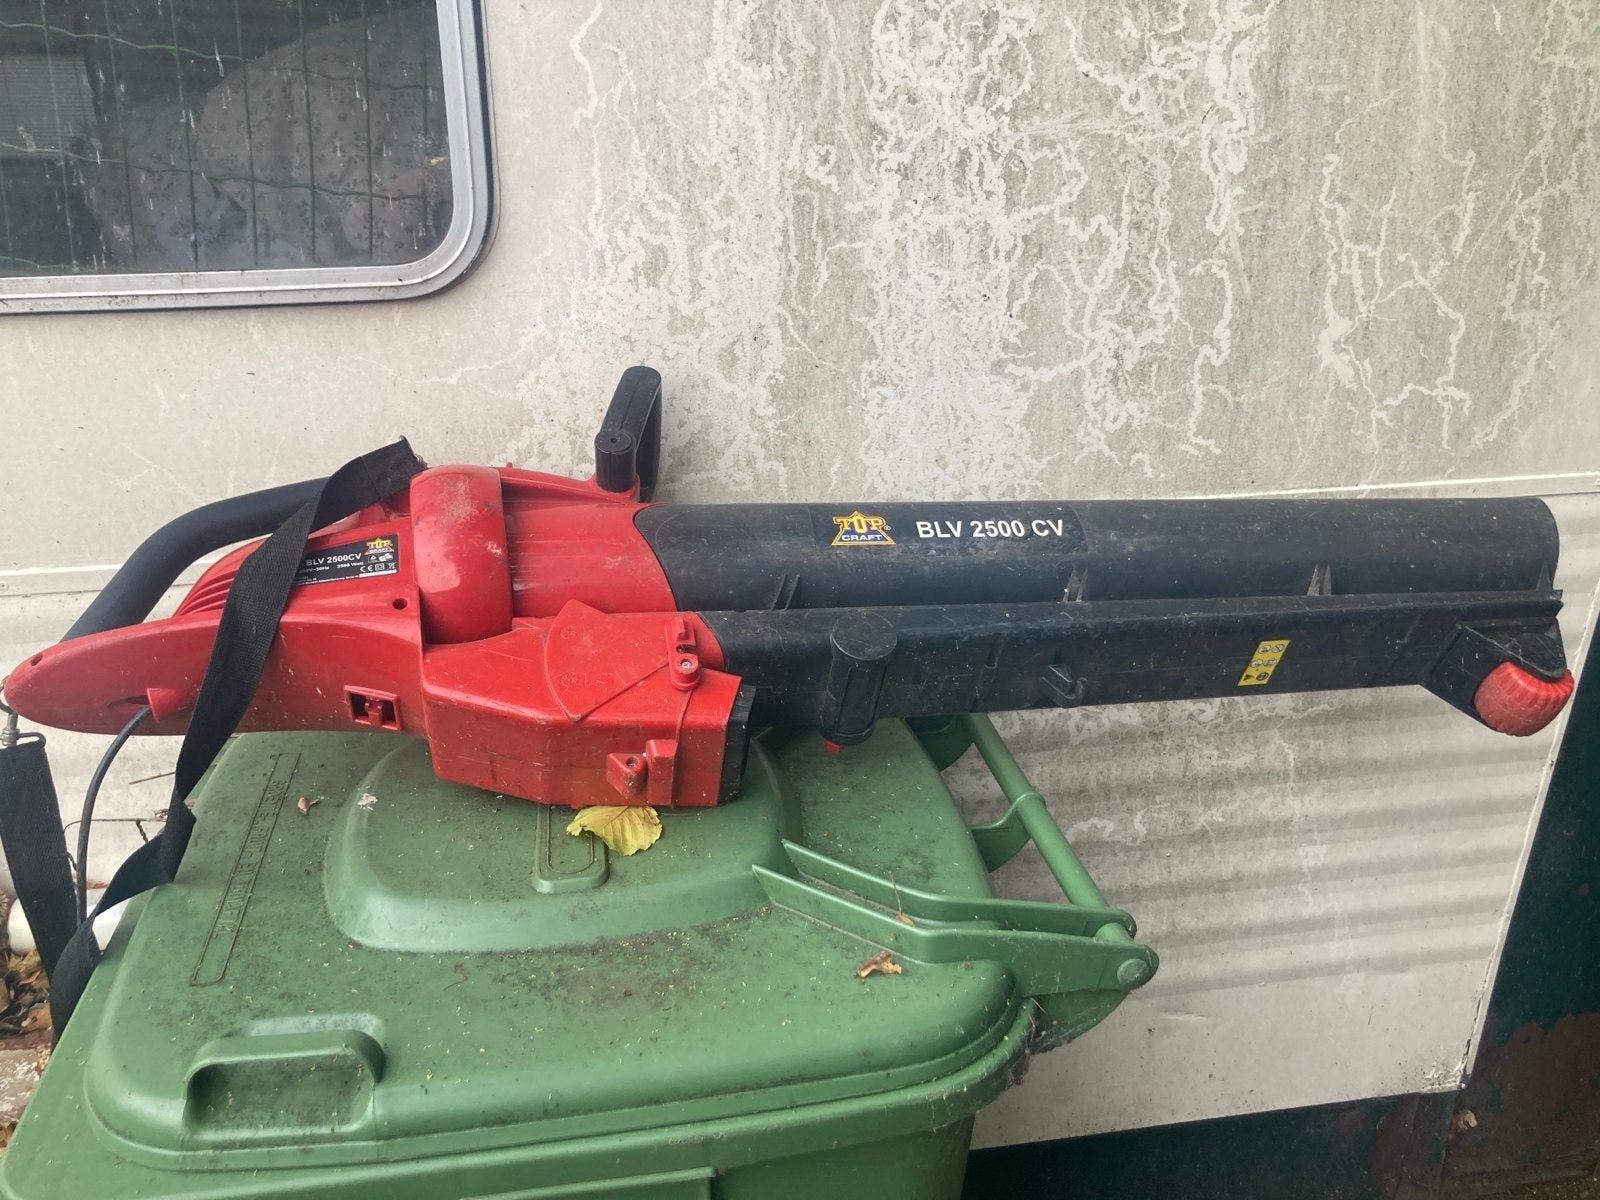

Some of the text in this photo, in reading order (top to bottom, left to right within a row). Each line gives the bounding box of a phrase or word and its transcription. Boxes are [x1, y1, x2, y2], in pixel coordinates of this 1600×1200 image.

[833, 513, 885, 534] TOP
[916, 519, 1064, 538] BLV 2500 CV
[305, 553, 362, 566] BLV 2500CV
